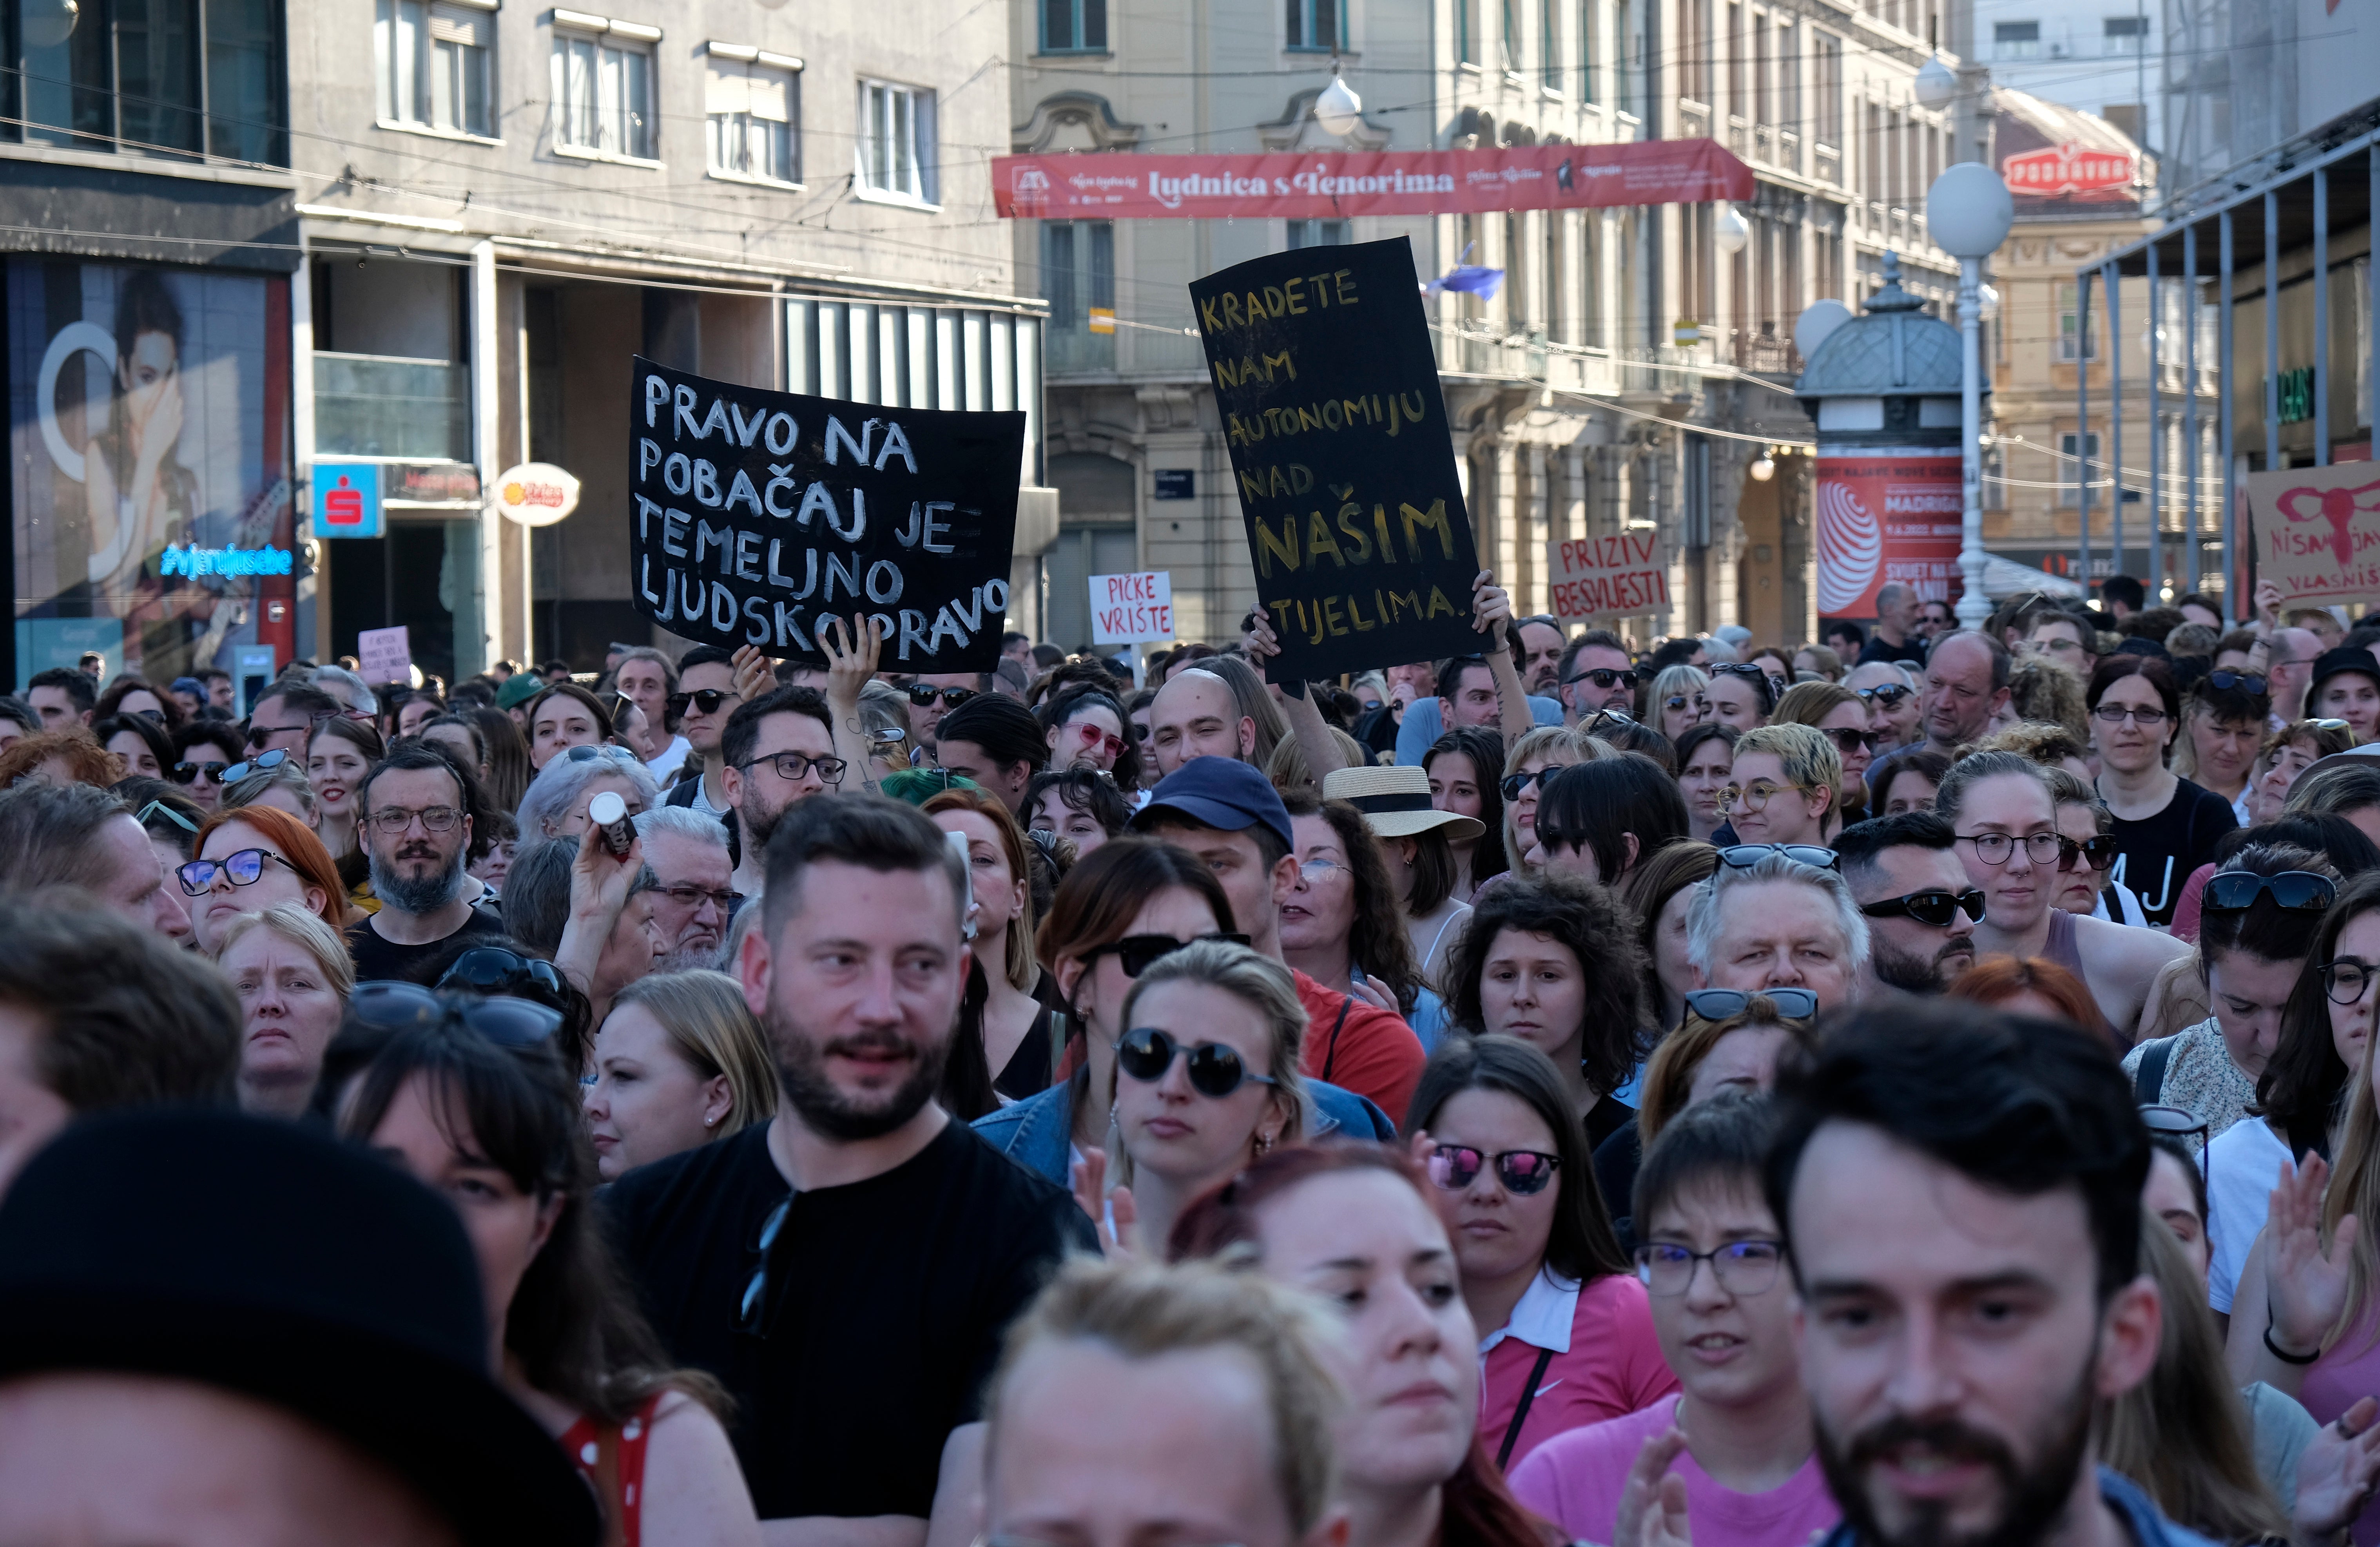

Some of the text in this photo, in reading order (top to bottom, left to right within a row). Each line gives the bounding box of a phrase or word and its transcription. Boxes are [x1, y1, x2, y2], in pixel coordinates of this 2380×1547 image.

[1149, 162, 1455, 208] Ludnica s Tenorima
[2013, 159, 2124, 183] PODRAVKA
[1201, 268, 1358, 333] KRADETE
[1214, 348, 1297, 389] NAM
[645, 374, 919, 474] PRAVO NA
[1229, 389, 1425, 448] AUTONOMIJU
[640, 437, 956, 554] POBAČAJ JE
[1239, 463, 1314, 504] NAD
[635, 492, 904, 605] TEMELJNO
[1254, 482, 1456, 580] NAŠIM
[1560, 533, 1656, 574] PRIZIV
[642, 553, 852, 659] LJUDSKO
[1108, 573, 1156, 604] PIČKE
[1269, 583, 1466, 645] TIJELIMA.
[1099, 602, 1171, 635] VRIŠTE
